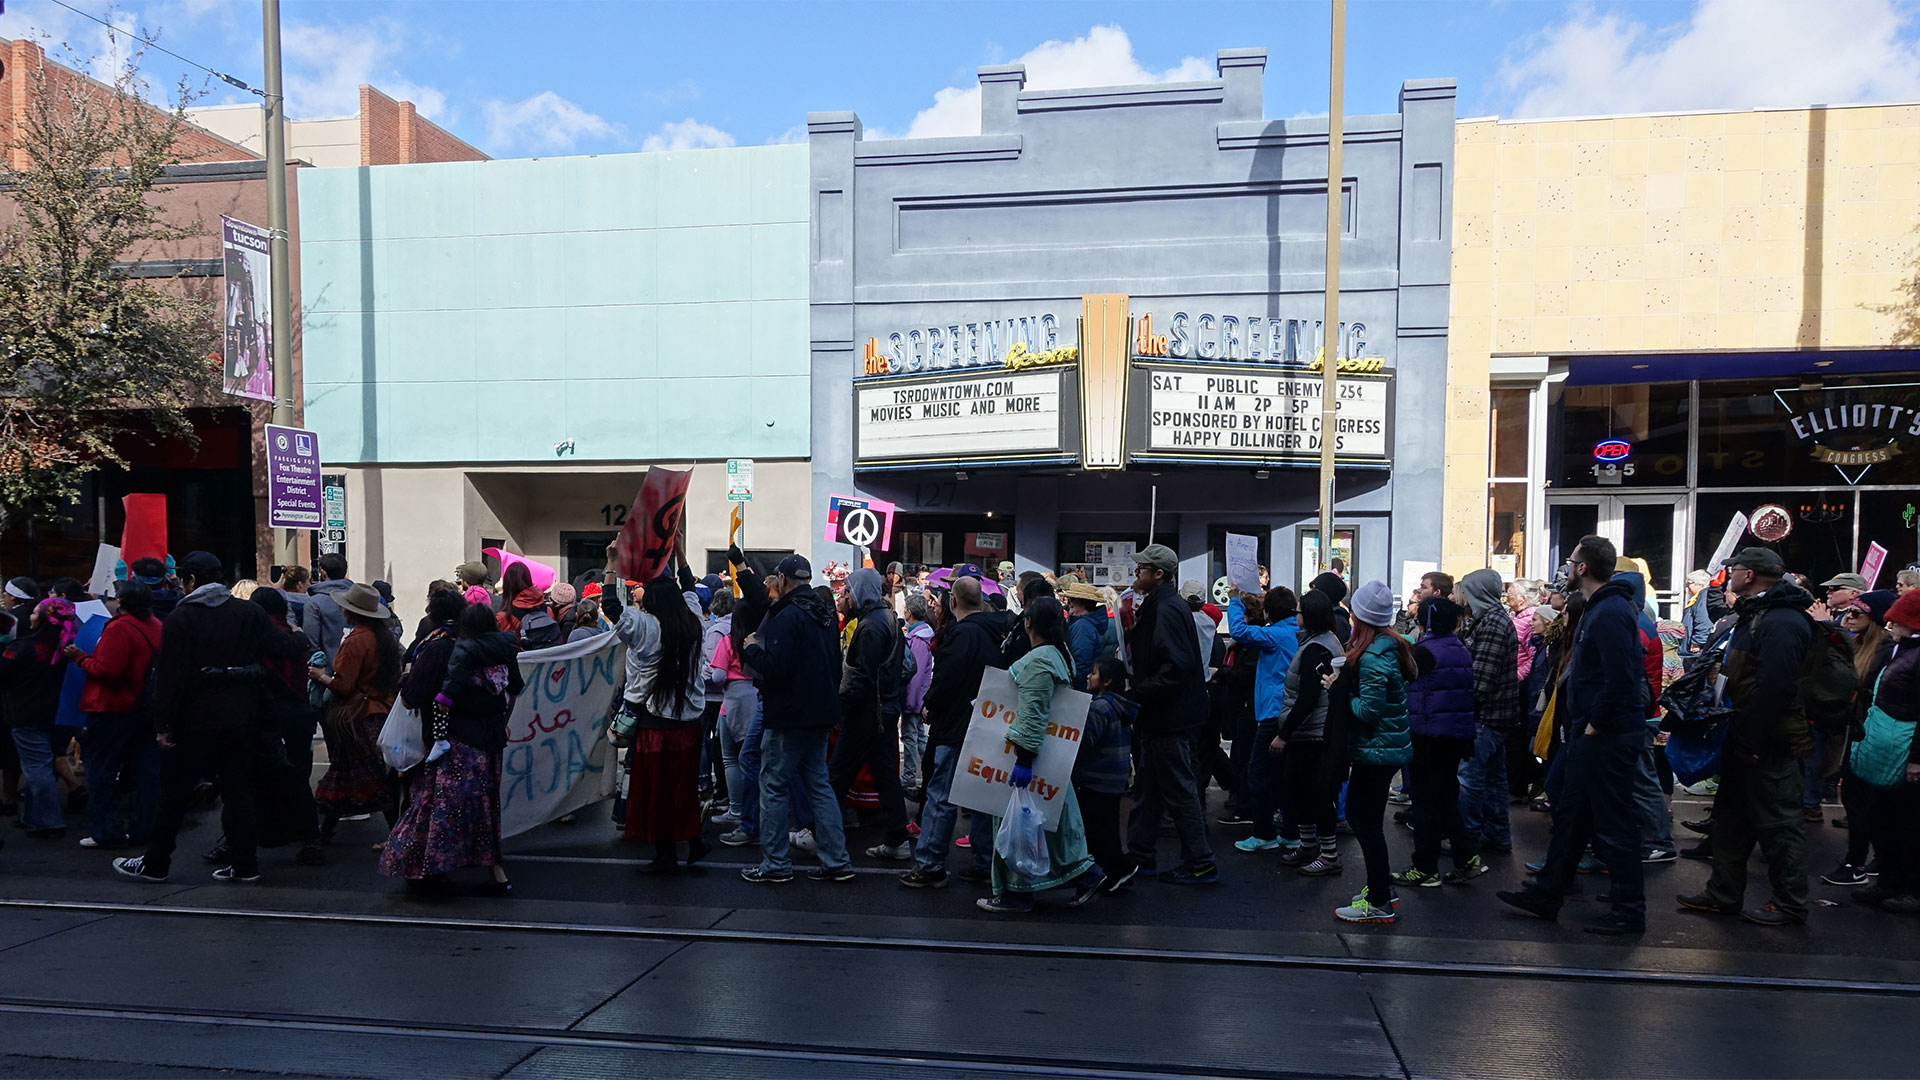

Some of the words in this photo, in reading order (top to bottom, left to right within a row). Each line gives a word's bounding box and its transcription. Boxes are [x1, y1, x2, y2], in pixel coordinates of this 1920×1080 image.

[232, 229, 267, 251] tucson
[864, 337, 888, 375] the
[887, 313, 1060, 373] SCREENING
[1136, 312, 1168, 356] the
[1005, 341, 1078, 371] Room
[893, 381, 1014, 404] TSRDOWNTOWN.COM
[1153, 375, 1182, 391] SAT
[1207, 377, 1259, 394] PUBLIC
[1277, 381, 1322, 397] ENEMY
[1340, 384, 1363, 399] 25¢
[870, 406, 912, 422] MOVIES
[923, 402, 960, 418] MUSIC
[970, 400, 996, 415] AND
[1006, 396, 1040, 412] MORE
[1254, 397, 1272, 412] 2P
[1291, 399, 1309, 414] 5P
[1153, 411, 1237, 428] SPONSORED
[1243, 415, 1261, 430] BY
[1265, 415, 1307, 431] HOTEL
[1312, 417, 1380, 434] CGRESS
[1173, 430, 1221, 446] HAPPY
[1230, 432, 1302, 448] DILLINGER
[1309, 435, 1344, 450] DS
[1593, 443, 1631, 458] OPEN
[1827, 450, 1886, 464] CONGRESS
[279, 463, 290, 472] Fox
[290, 464, 312, 474] Theatre
[1590, 463, 1635, 477] 135
[276, 474, 316, 486] Entertainment
[286, 485, 307, 495] District
[277, 498, 297, 508] Special
[298, 500, 317, 509] Events
[913, 482, 957, 507] 127
[601, 504, 633, 526] 12
[981, 700, 1081, 742] O'oam
[967, 756, 1060, 801] Equity
